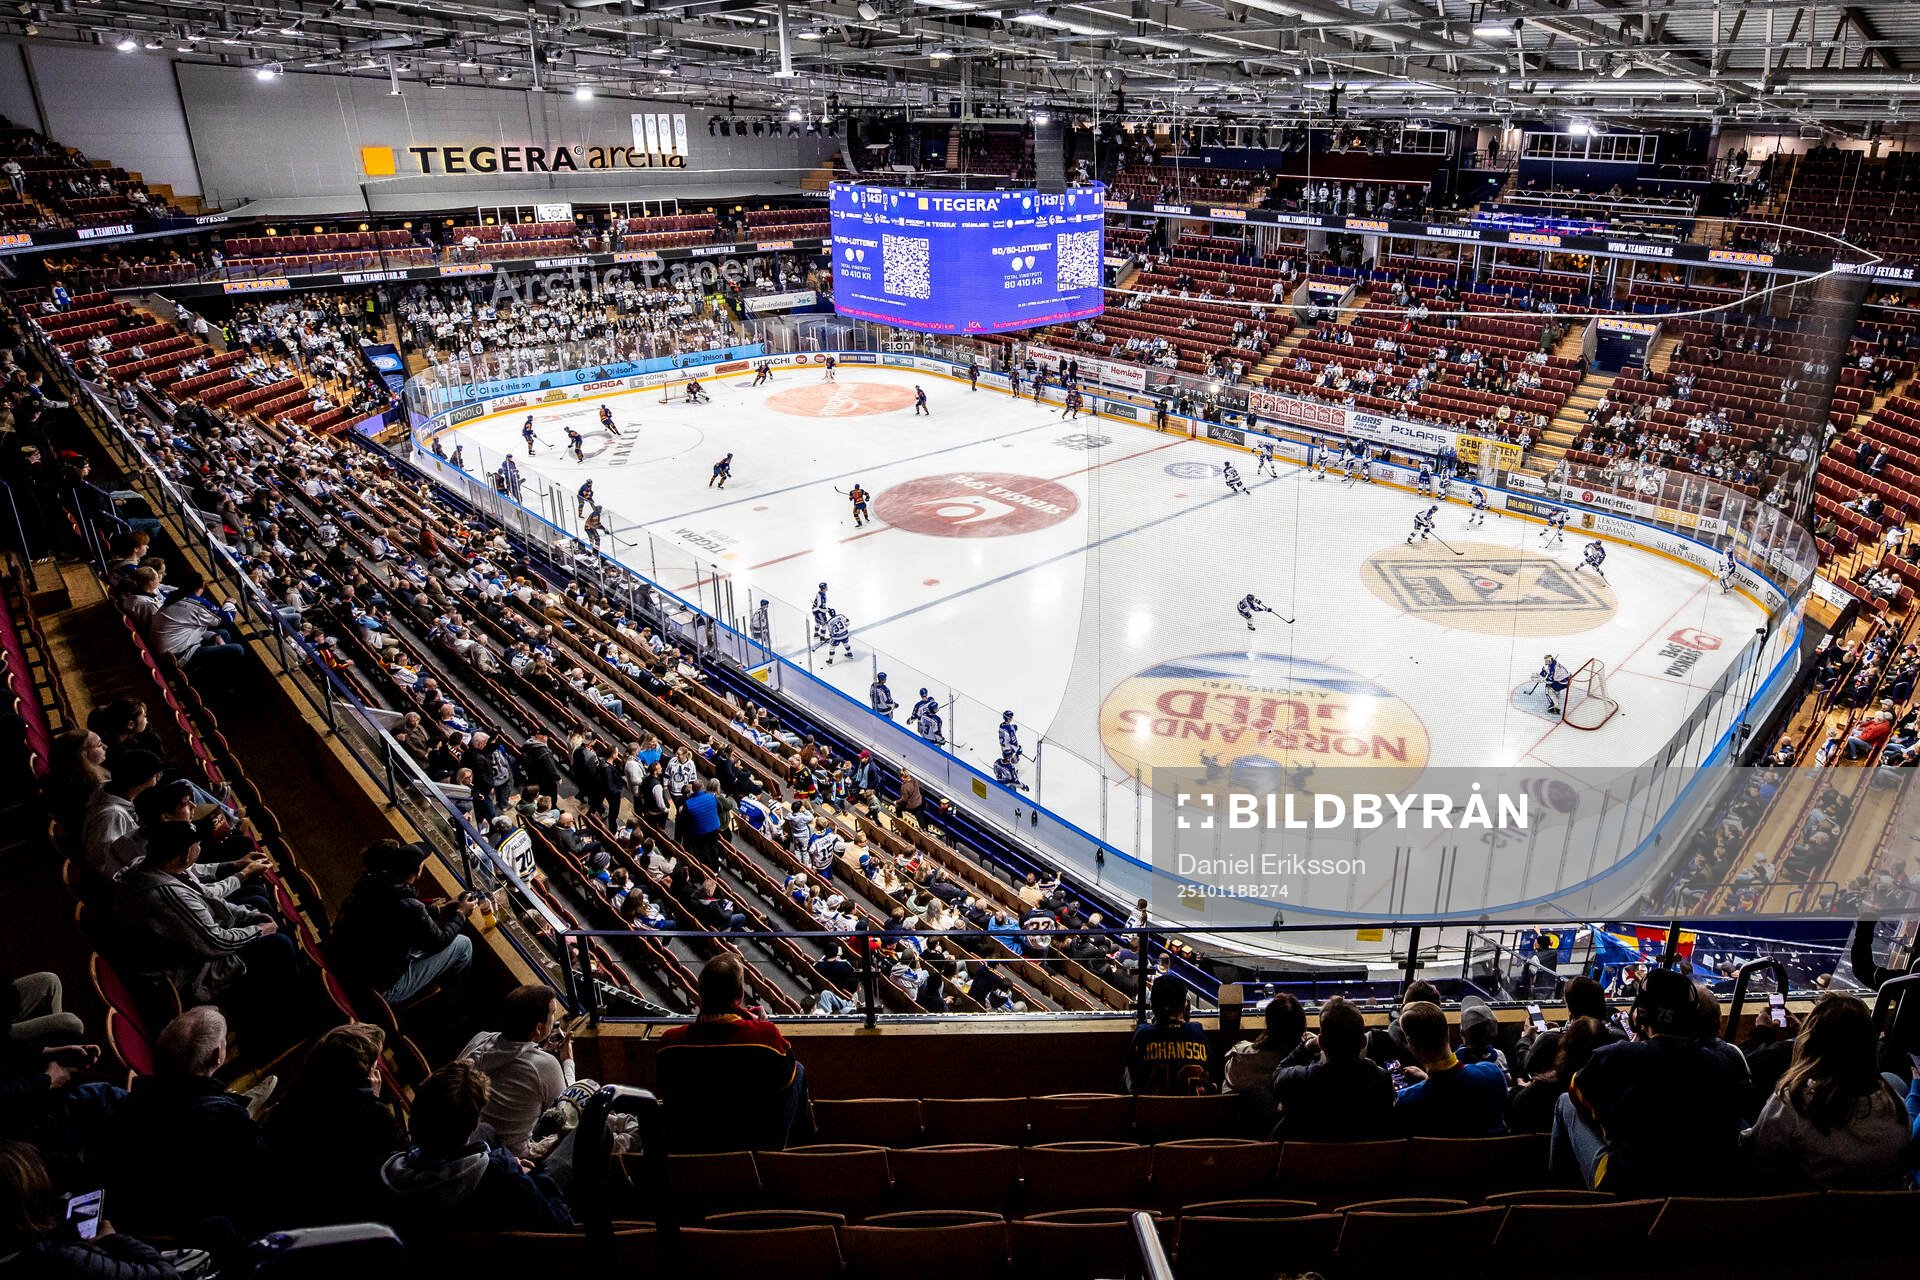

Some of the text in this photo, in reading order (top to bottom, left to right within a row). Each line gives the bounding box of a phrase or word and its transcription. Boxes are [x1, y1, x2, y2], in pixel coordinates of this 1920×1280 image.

[77, 223, 134, 240] WWW.TEAMFETAB.SE
[1427, 226, 1481, 239] WWW.TEAMFETAB.SE
[1509, 232, 1561, 245] FETAB
[1608, 241, 1673, 257] WWW.TEAMFETAB.SE
[534, 257, 589, 270] WWW.TEAMFETAB.SE
[1708, 250, 1774, 264] FETAB
[224, 279, 290, 292] FETAB
[490, 253, 757, 308] Arctic Paper
[1017, 279, 1031, 288] 410
[1032, 277, 1043, 286] KR
[968, 321, 981, 329] ICA
[753, 356, 791, 369] HITACHI
[1029, 349, 1057, 362] Hemköp
[1110, 365, 1143, 380] Hemköp
[583, 379, 624, 392] BORGA
[1353, 414, 1382, 426] ABRIS
[1391, 425, 1447, 444] POLARIS
[1597, 524, 1636, 538] KOMMUN
[1684, 549, 1707, 566] NEWS
[832, 620, 845, 634] 33
[1117, 708, 1409, 763] NORRLANDS
[516, 848, 533, 873] 70
